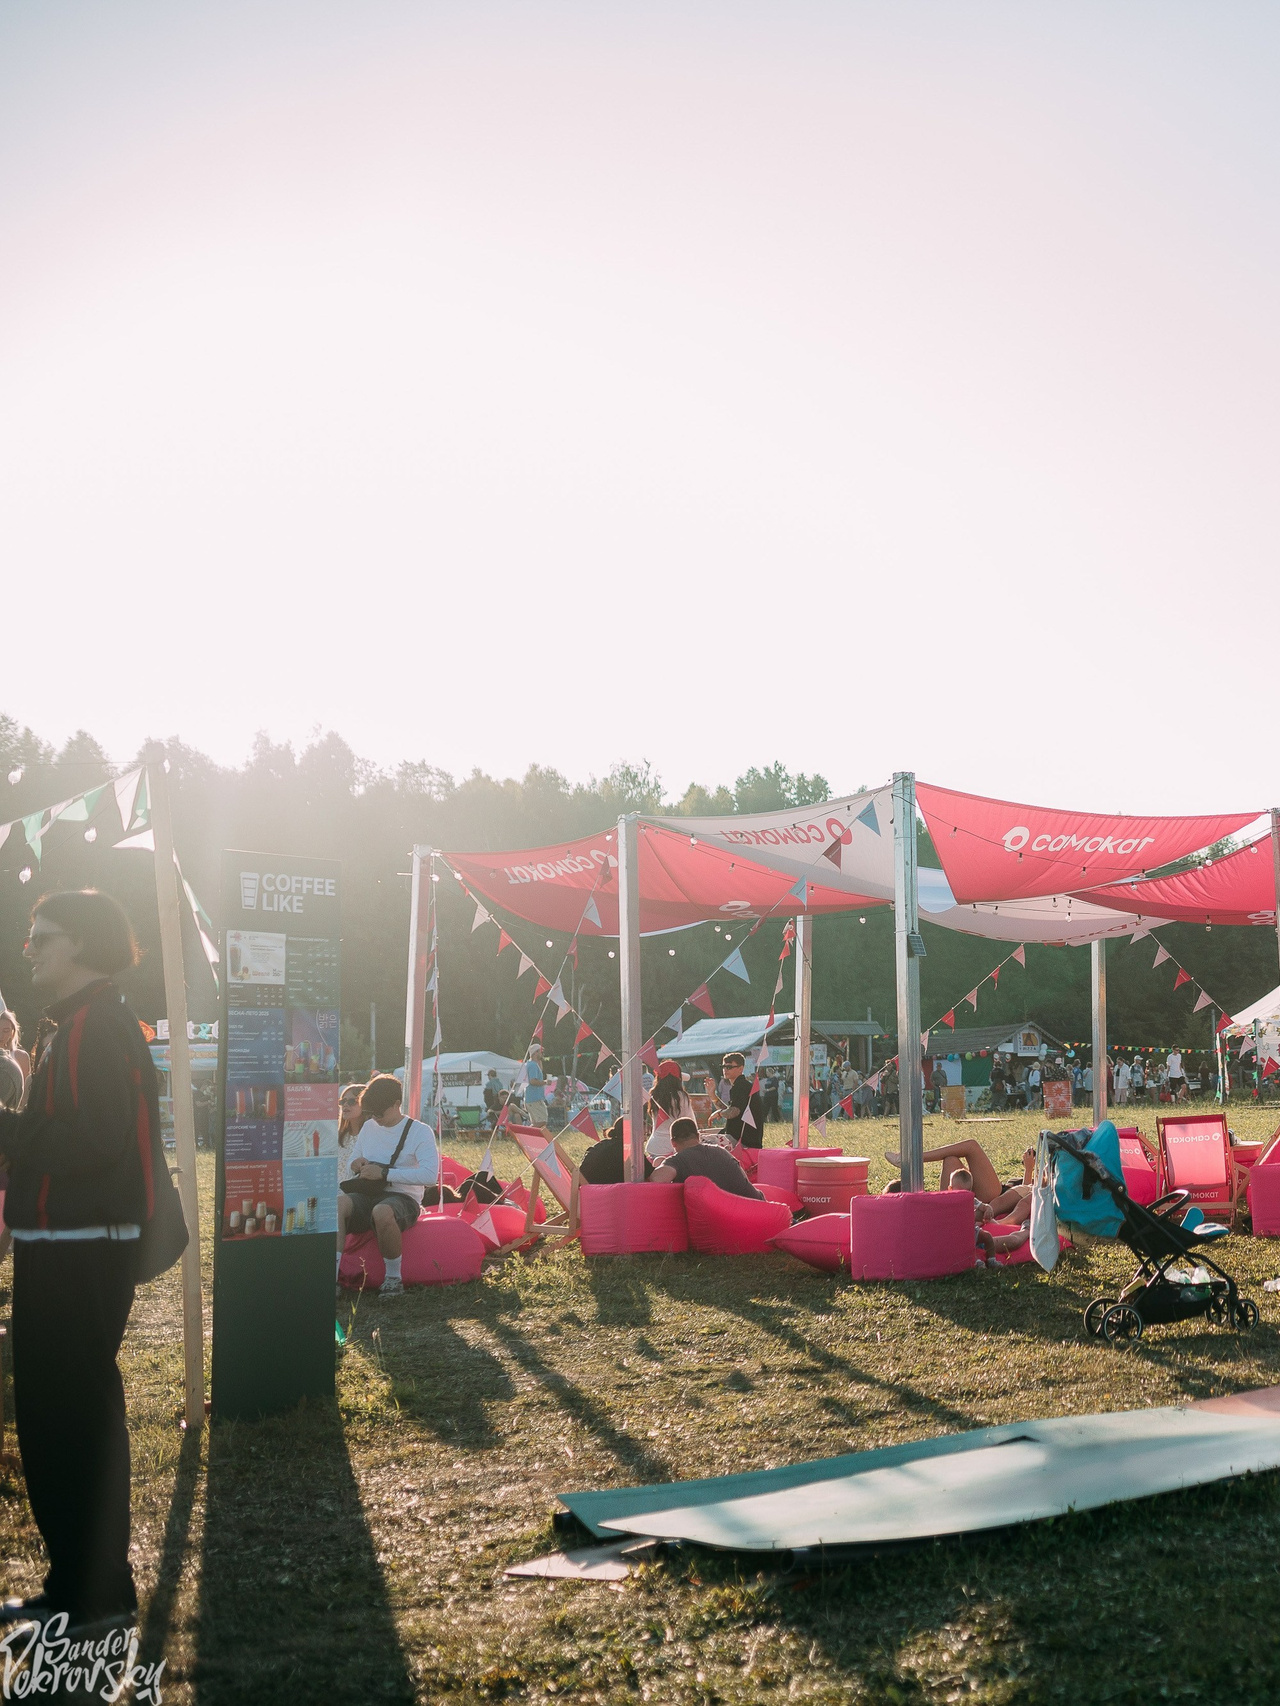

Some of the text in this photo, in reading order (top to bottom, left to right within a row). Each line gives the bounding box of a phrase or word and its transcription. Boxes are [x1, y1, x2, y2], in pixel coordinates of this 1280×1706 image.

[720, 824, 825, 845] самокат
[1031, 833, 1155, 855] самокат
[504, 856, 592, 885] самокат
[262, 873, 336, 897] COFFEE
[262, 892, 304, 914] LIKE
[802, 1196, 832, 1204] амокат
